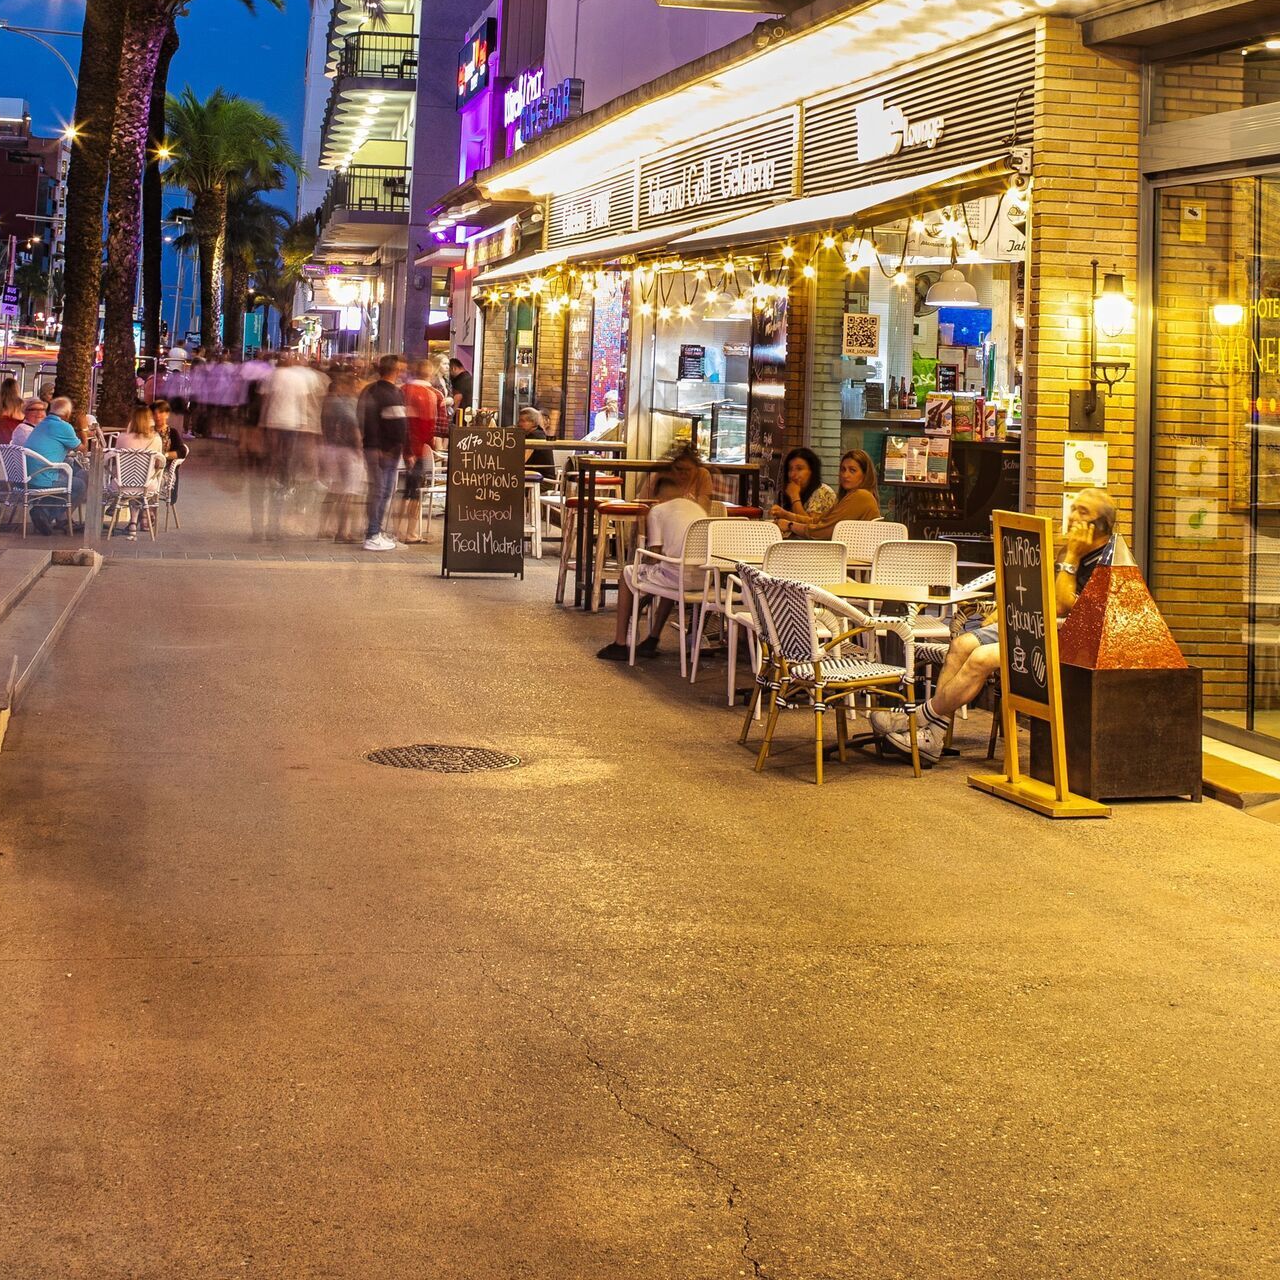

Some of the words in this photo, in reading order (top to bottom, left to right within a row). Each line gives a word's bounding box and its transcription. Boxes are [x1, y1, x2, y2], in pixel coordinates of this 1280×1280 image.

[903, 116, 944, 148] Lounge
[1216, 337, 1276, 375] XAINE
[486, 429, 516, 451] 28/5
[475, 488, 487, 500] 21
[1003, 535, 1041, 568] CHURROS
